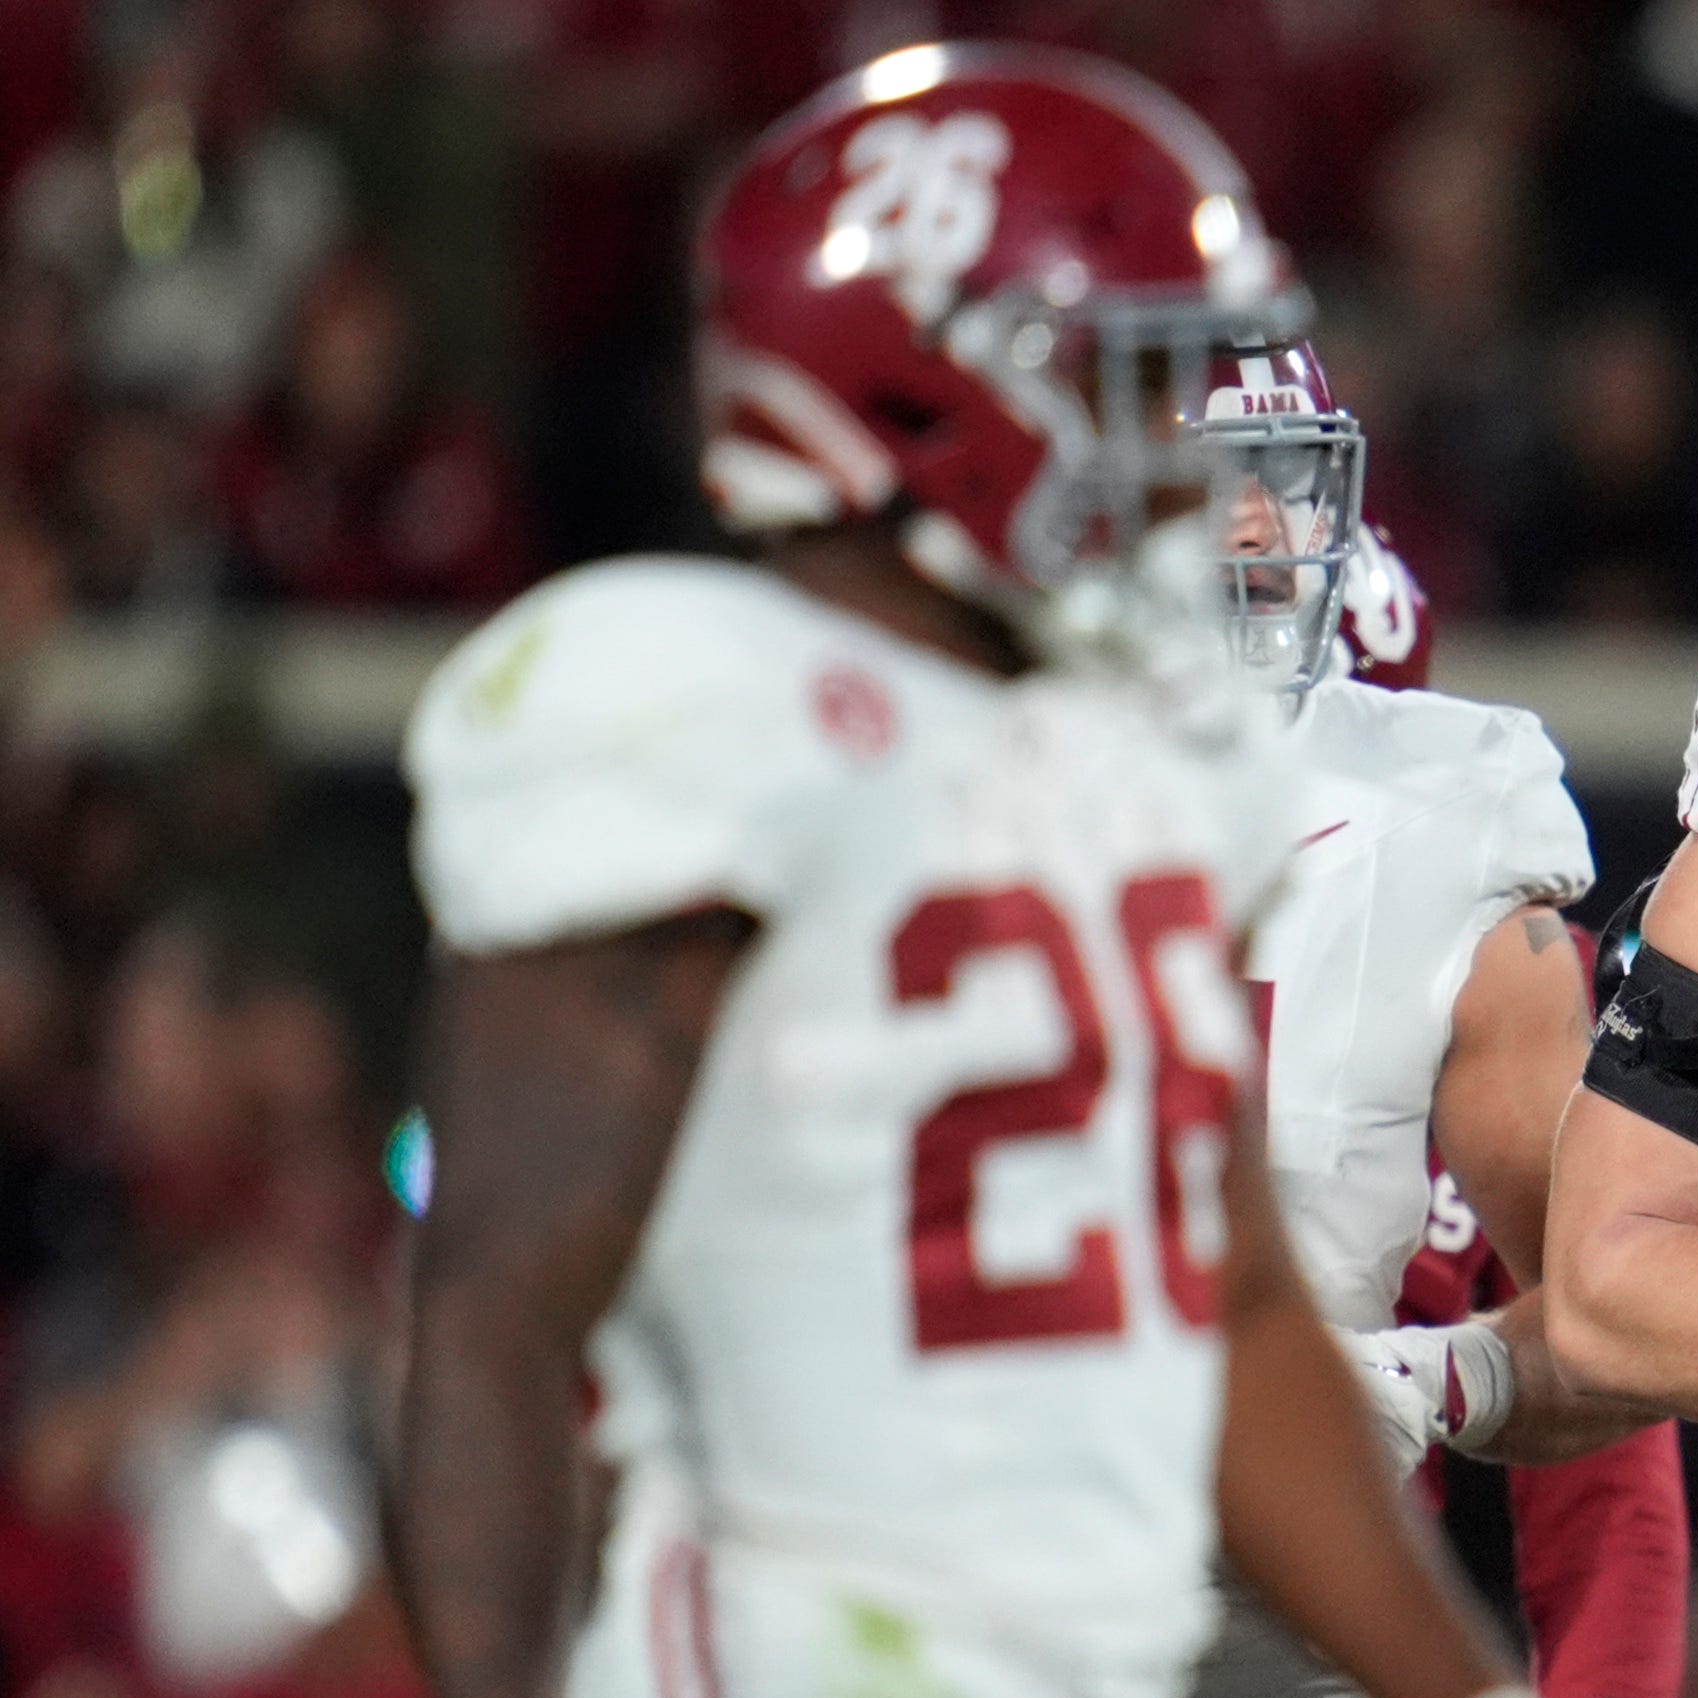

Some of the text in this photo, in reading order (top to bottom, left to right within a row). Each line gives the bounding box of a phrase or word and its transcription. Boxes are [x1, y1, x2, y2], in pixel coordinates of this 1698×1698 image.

[805, 112, 1012, 290] 26
[1241, 391, 1300, 416] BAMA
[889, 869, 1235, 1357] 26
